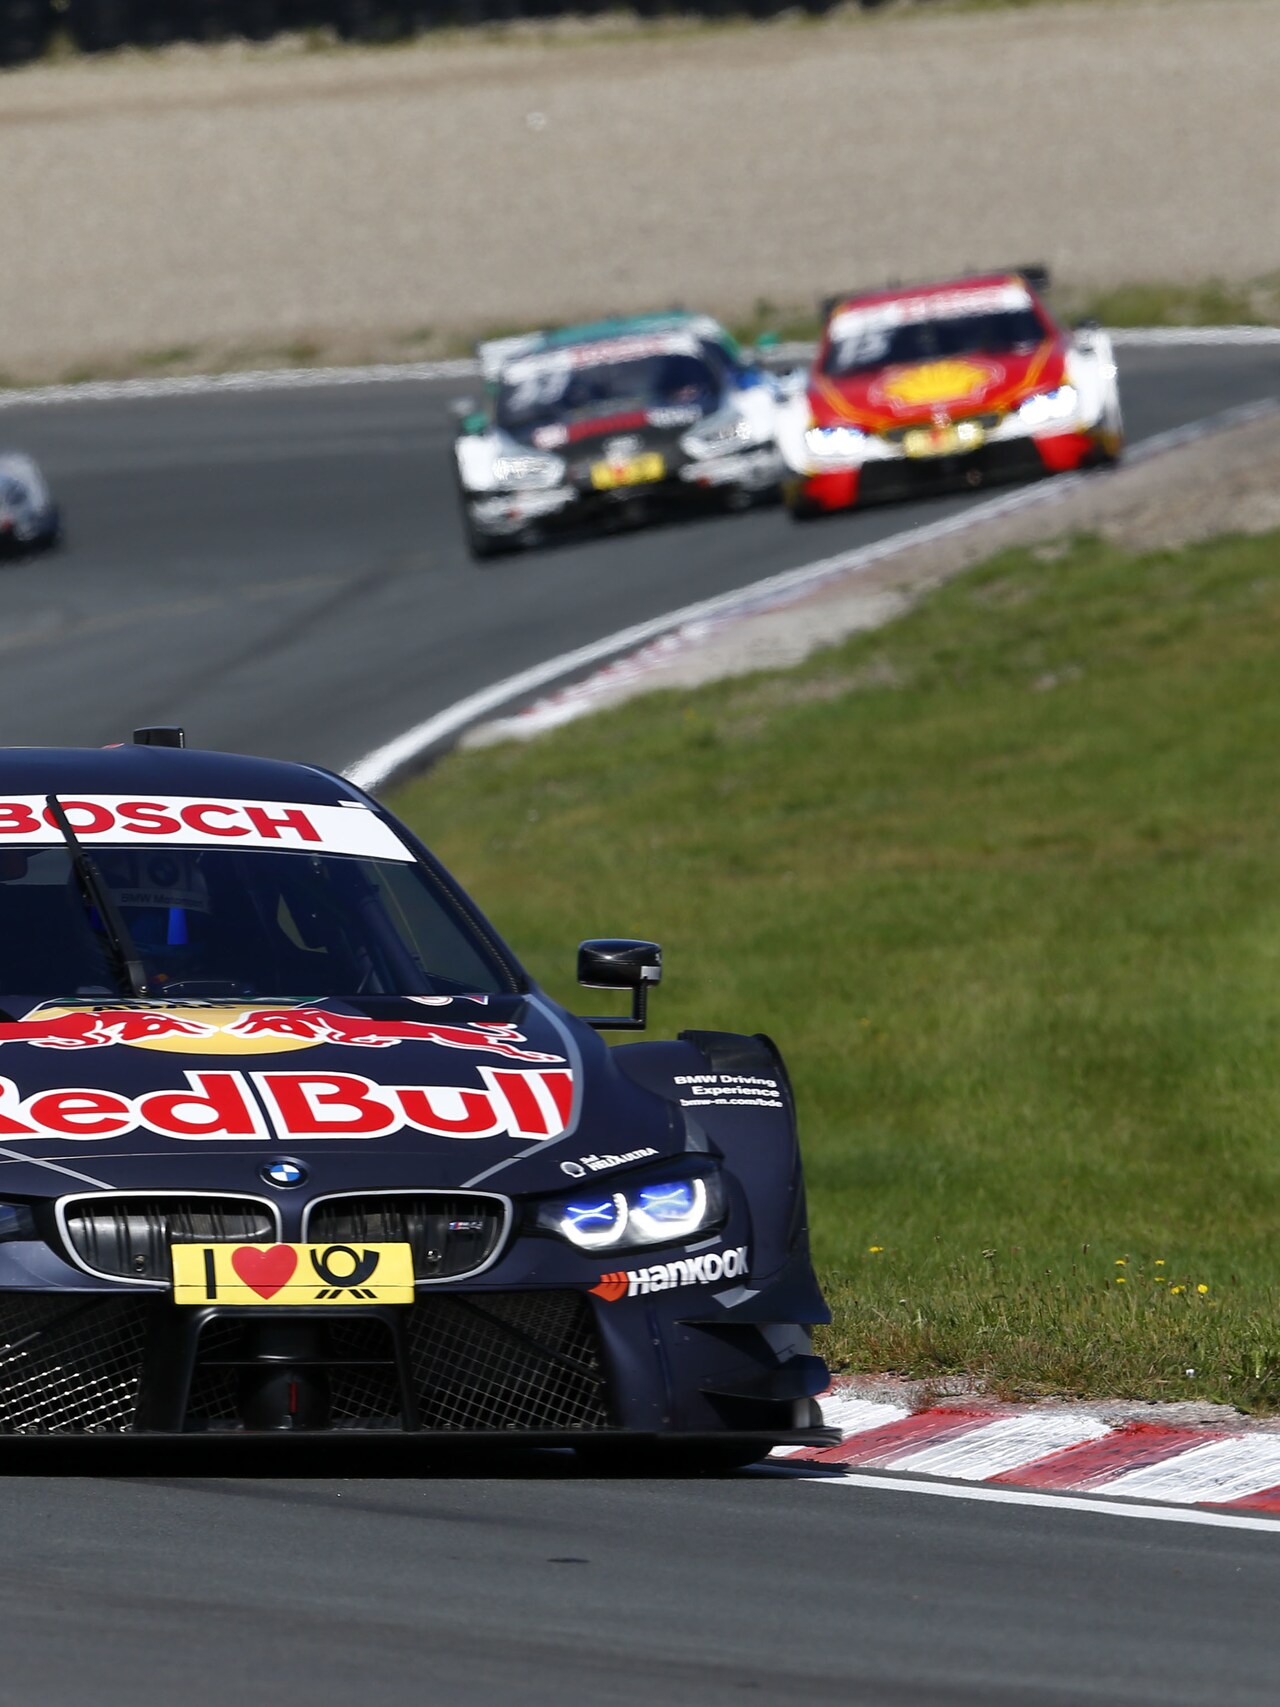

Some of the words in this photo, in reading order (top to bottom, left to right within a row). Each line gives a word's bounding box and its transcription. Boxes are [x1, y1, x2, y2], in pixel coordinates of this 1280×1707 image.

[673, 1075, 717, 1085] BMW
[719, 1074, 778, 1088] Driving
[691, 1085, 780, 1098] Experience
[252, 1068, 573, 1140] Bull
[680, 1098, 783, 1108] bmw-m.com/bde
[203, 1248, 218, 1300] I
